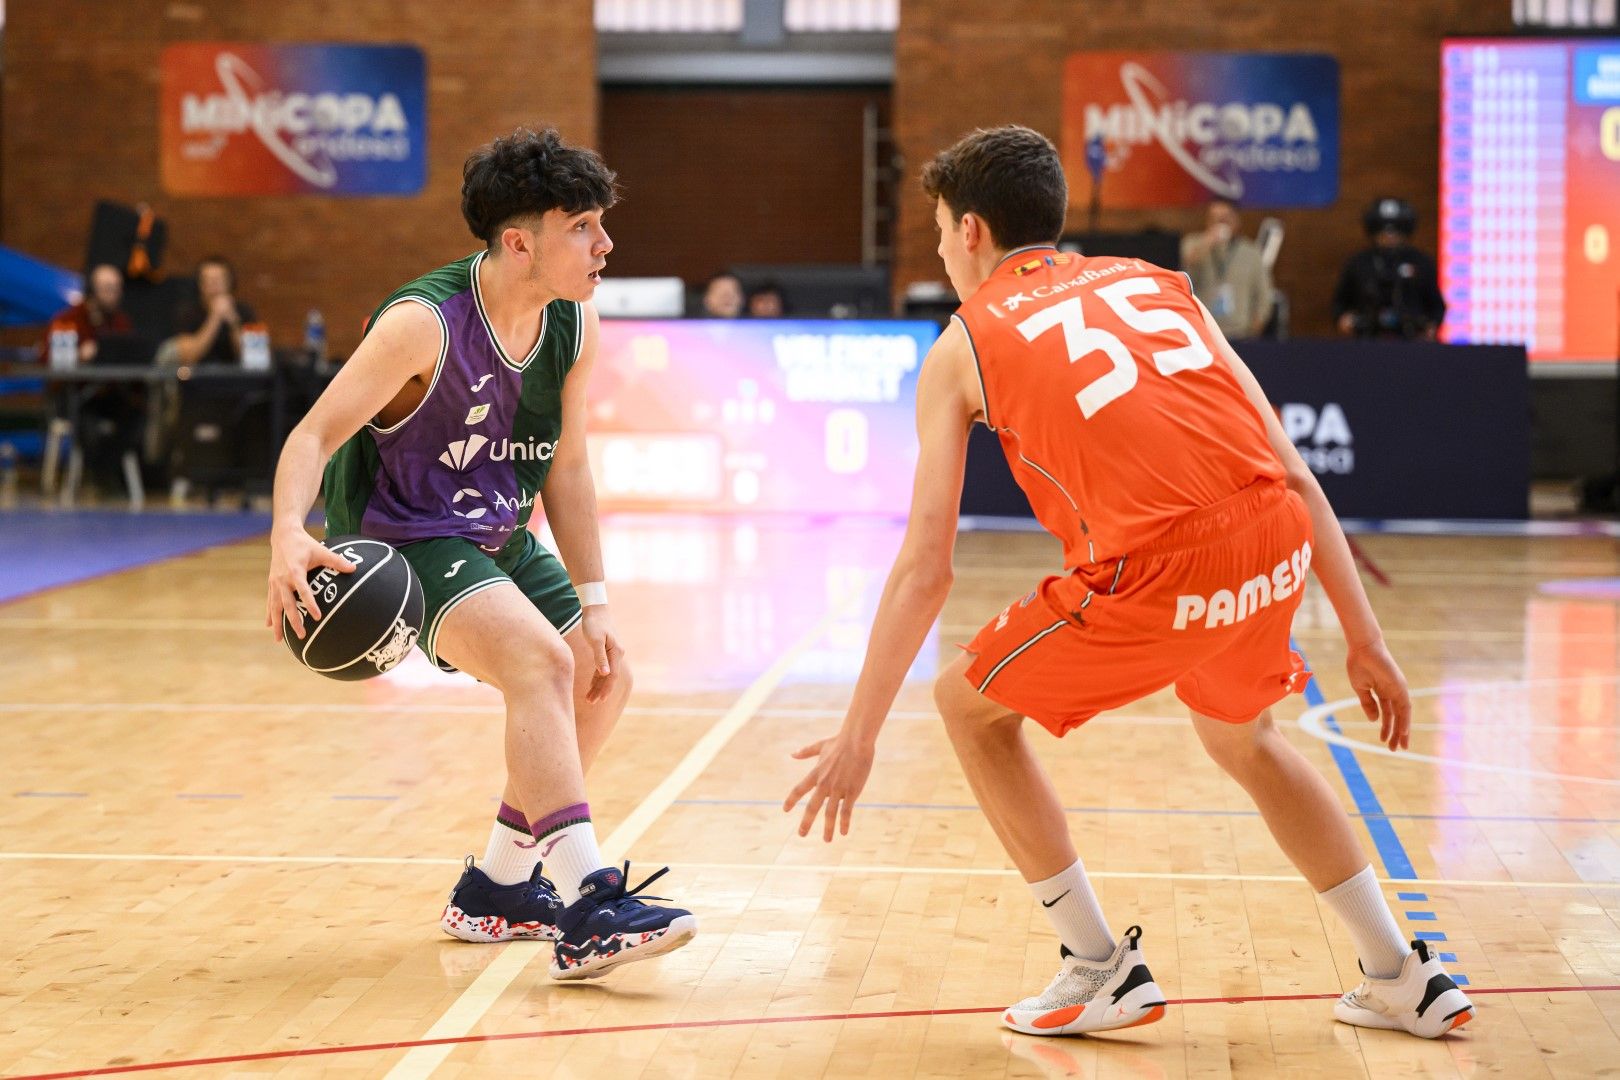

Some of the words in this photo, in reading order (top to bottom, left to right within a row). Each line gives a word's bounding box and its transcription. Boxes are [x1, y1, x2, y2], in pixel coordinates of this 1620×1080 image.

[1031, 262, 1127, 298] CaixaBank
[1016, 276, 1214, 420] 35
[1281, 402, 1353, 446] PA
[1172, 540, 1312, 630] PAMESA
